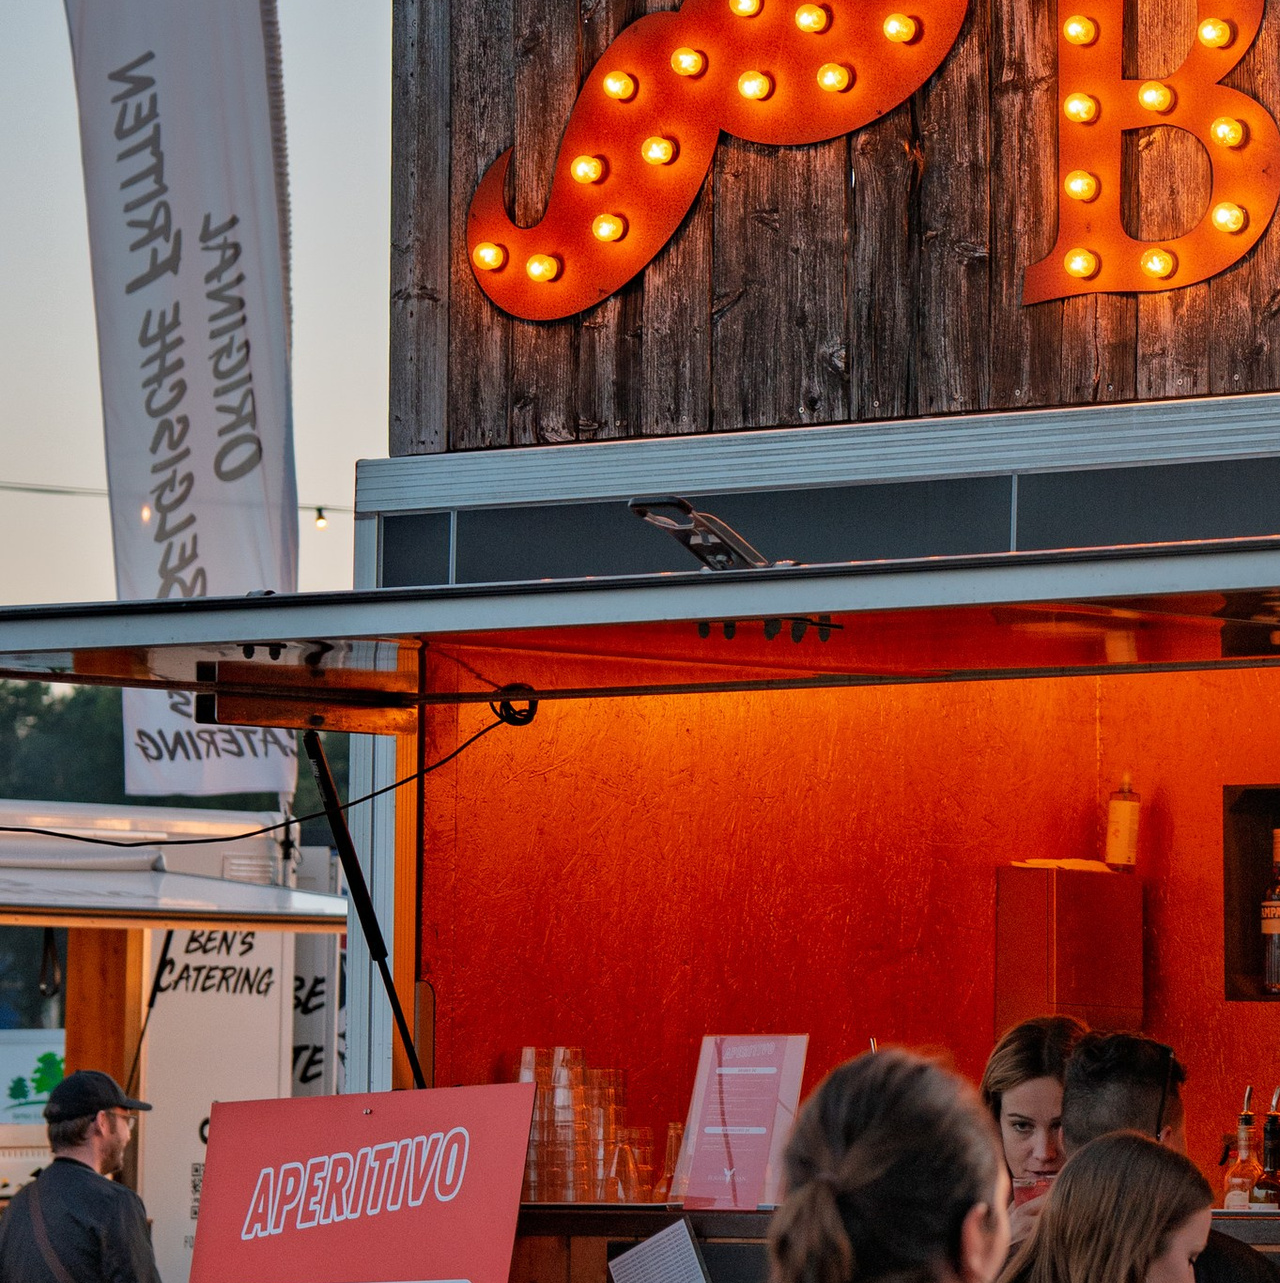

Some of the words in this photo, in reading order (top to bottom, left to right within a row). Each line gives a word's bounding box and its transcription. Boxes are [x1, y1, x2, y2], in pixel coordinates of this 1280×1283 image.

[184, 930, 256, 957] BEN'S
[157, 959, 275, 997] CATERING
[240, 1126, 470, 1241] APERITIVO
